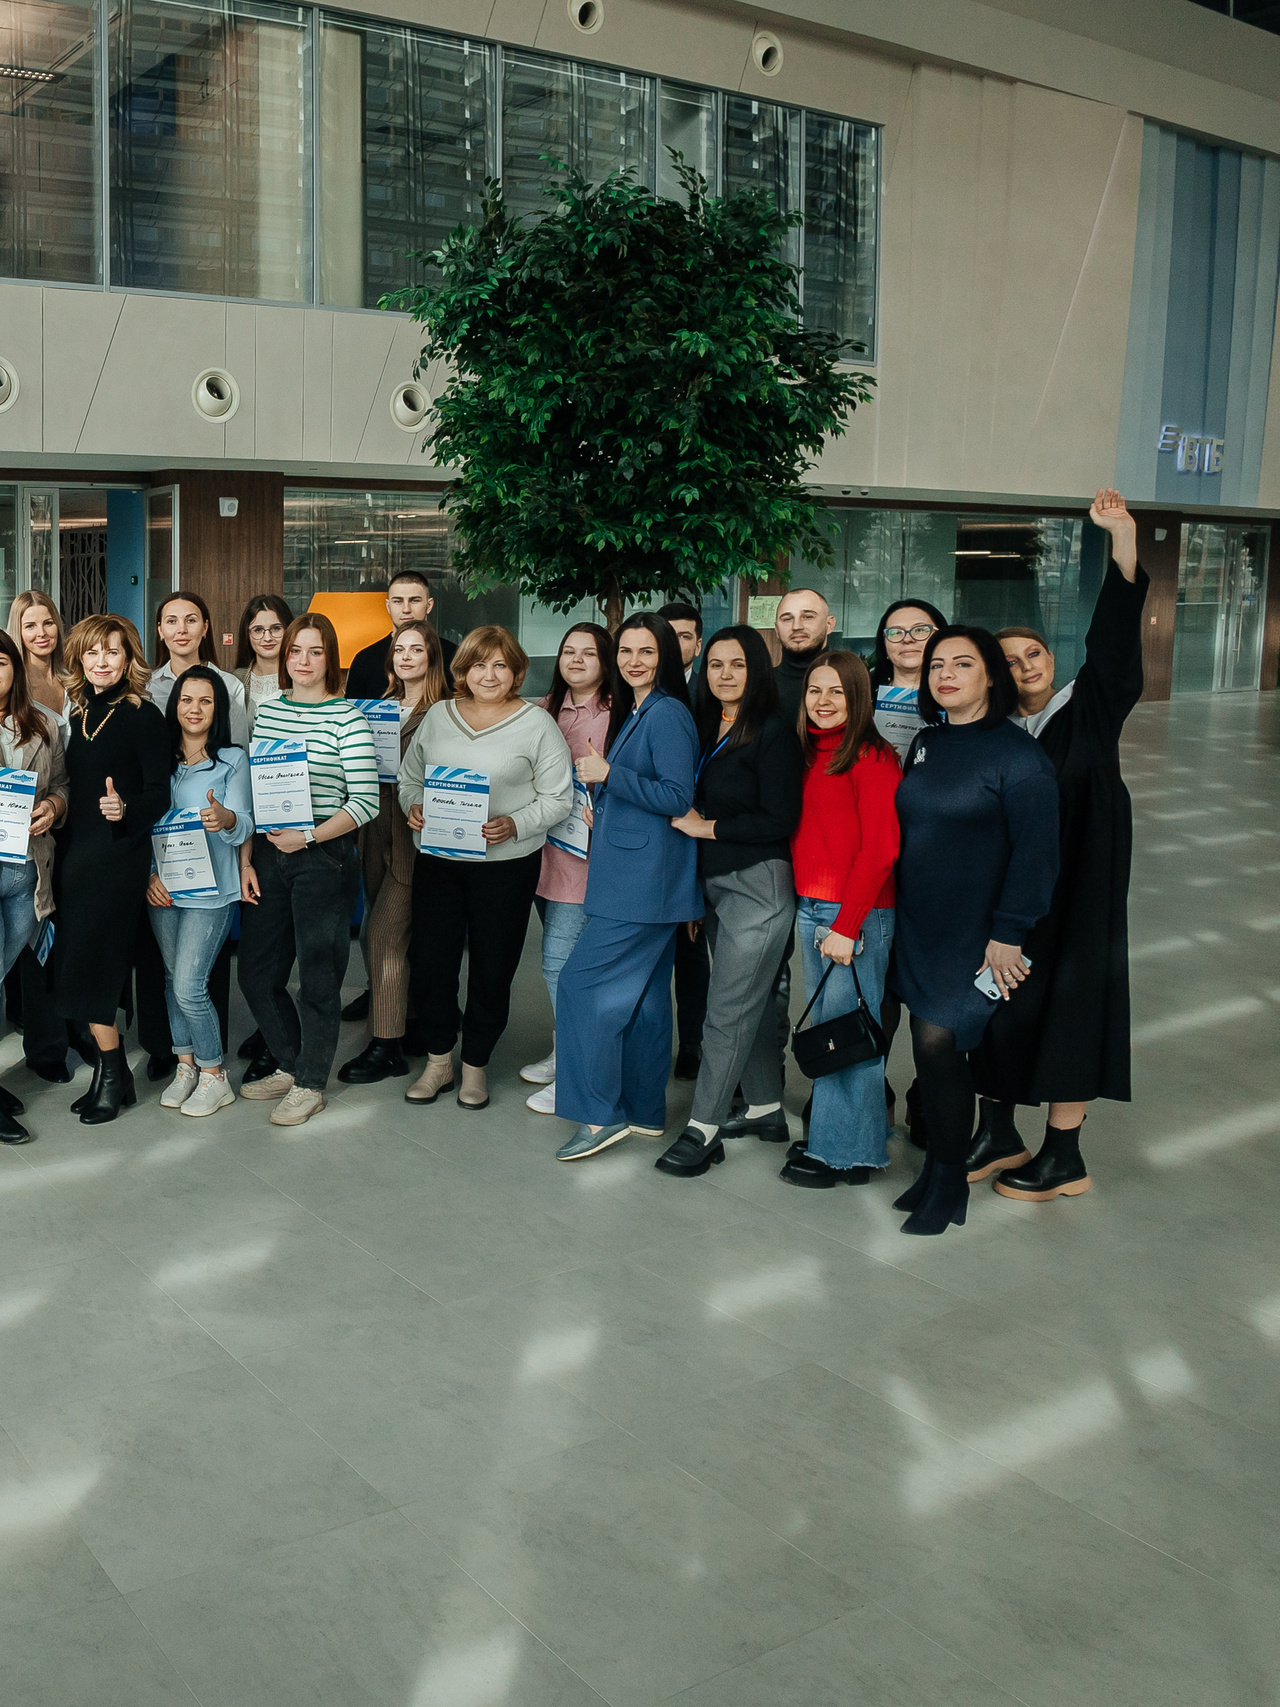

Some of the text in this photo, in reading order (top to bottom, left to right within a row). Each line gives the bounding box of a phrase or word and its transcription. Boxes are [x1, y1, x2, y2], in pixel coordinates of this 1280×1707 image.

[1177, 435, 1224, 473] ВТБ
[880, 702, 919, 712] СЕРТИФИК
[252, 755, 287, 763] СЕРТИФИКАТ
[427, 780, 467, 790] СЕРТИФИКАТ
[152, 824, 185, 834] СЕРТИФИКАТ
